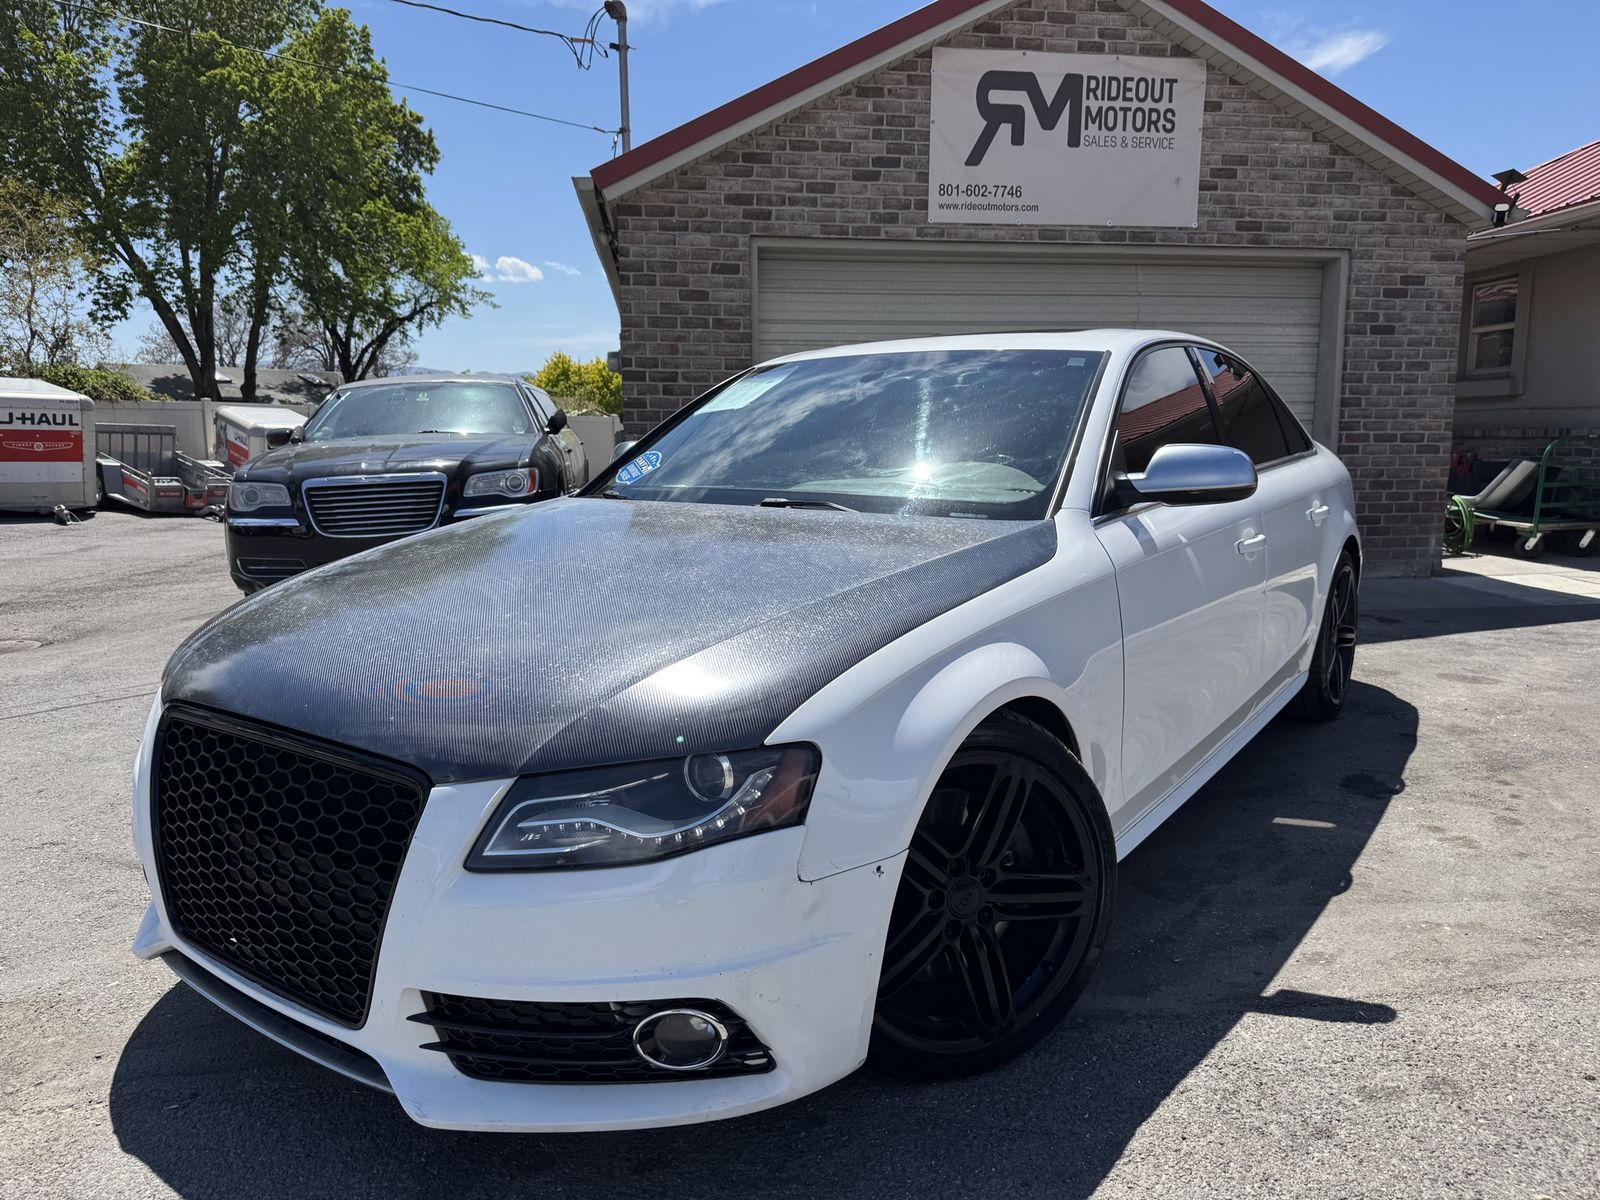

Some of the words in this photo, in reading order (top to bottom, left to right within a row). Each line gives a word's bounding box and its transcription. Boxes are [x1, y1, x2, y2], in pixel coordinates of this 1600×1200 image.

[1085, 75, 1179, 104] RIDEOUT
[1083, 105, 1177, 134] MOTORS
[1083, 135, 1117, 148] SALES
[1121, 136, 1129, 148] &
[1131, 136, 1175, 150] SERVICE
[938, 183, 1022, 198] 801-602-7746
[938, 202, 1039, 212] www.rideoutmotors.com
